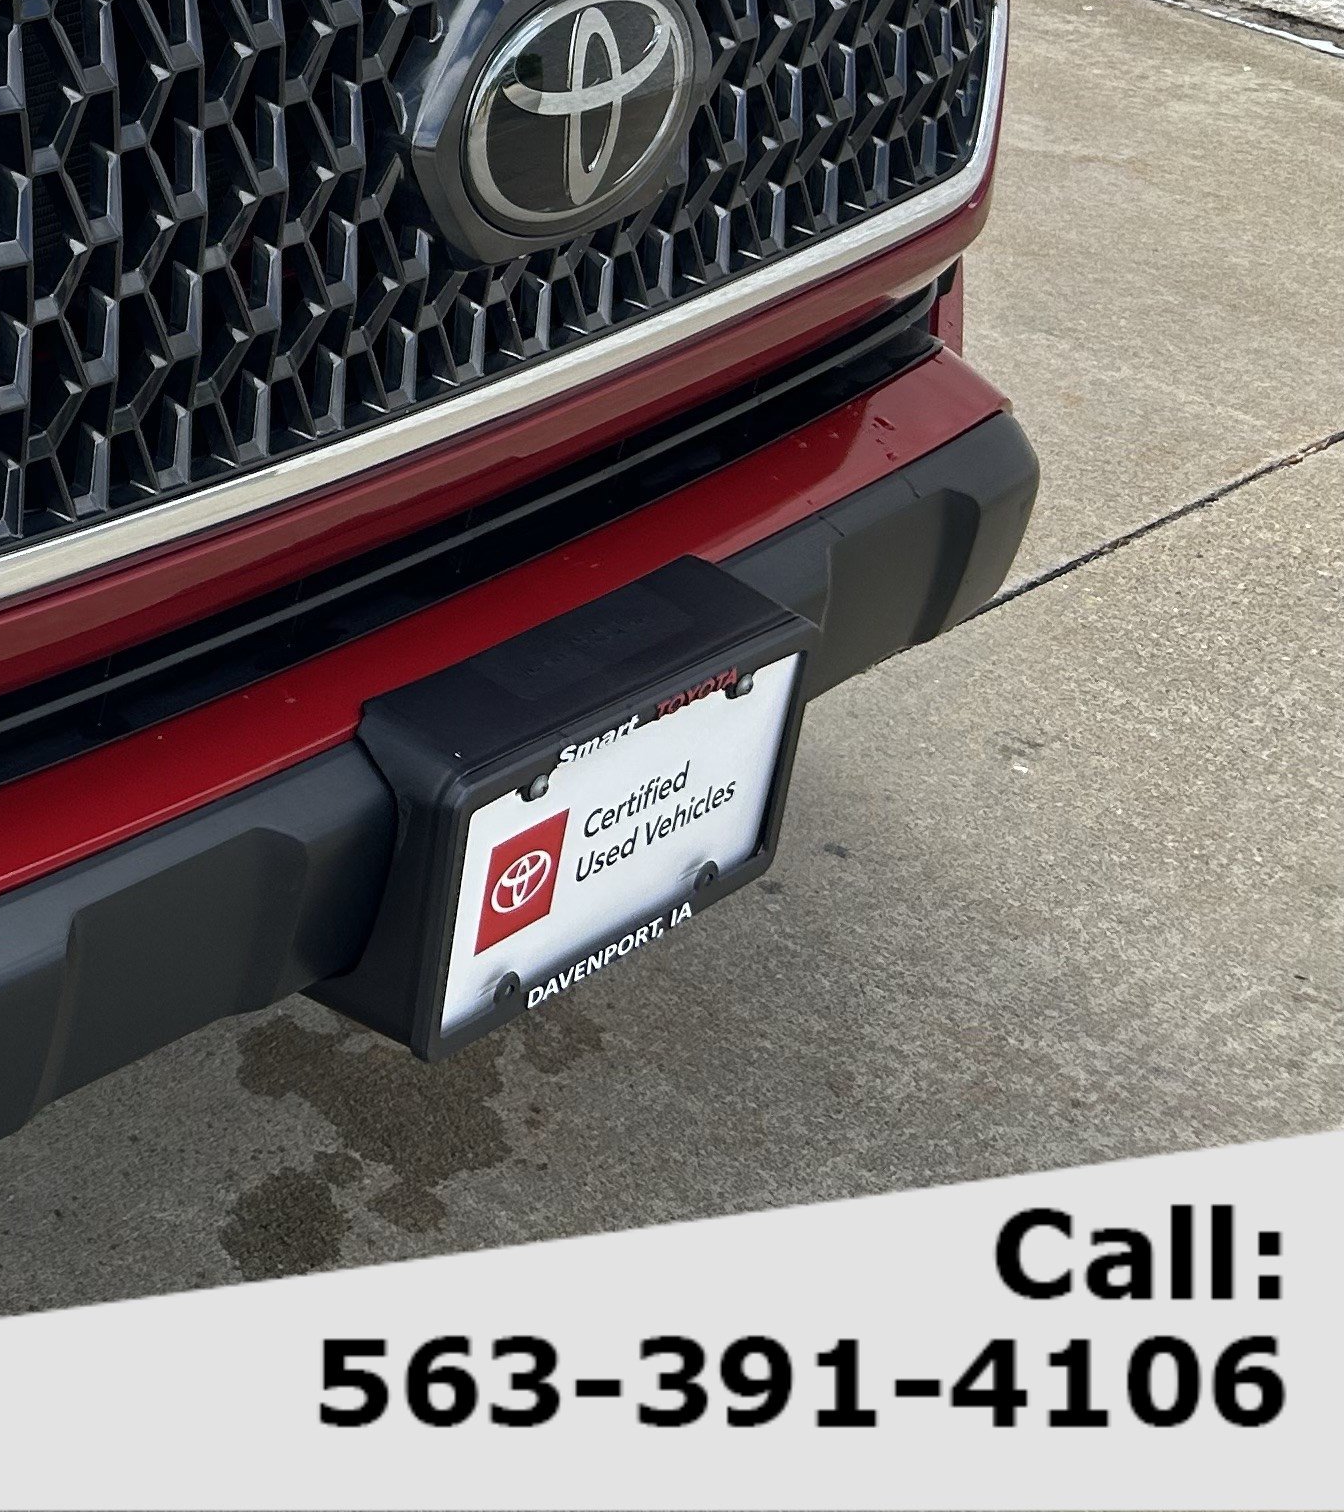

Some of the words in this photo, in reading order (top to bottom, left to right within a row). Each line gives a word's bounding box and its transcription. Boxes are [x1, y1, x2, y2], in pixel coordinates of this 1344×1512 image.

[558, 714, 639, 765] Smart
[655, 667, 738, 719] TOYOTA
[574, 828, 636, 882] Used
[643, 778, 737, 847] Vehicles
[582, 761, 690, 838] Certified
[526, 916, 666, 1010] DAVENPORT,
[669, 901, 694, 930] IA
